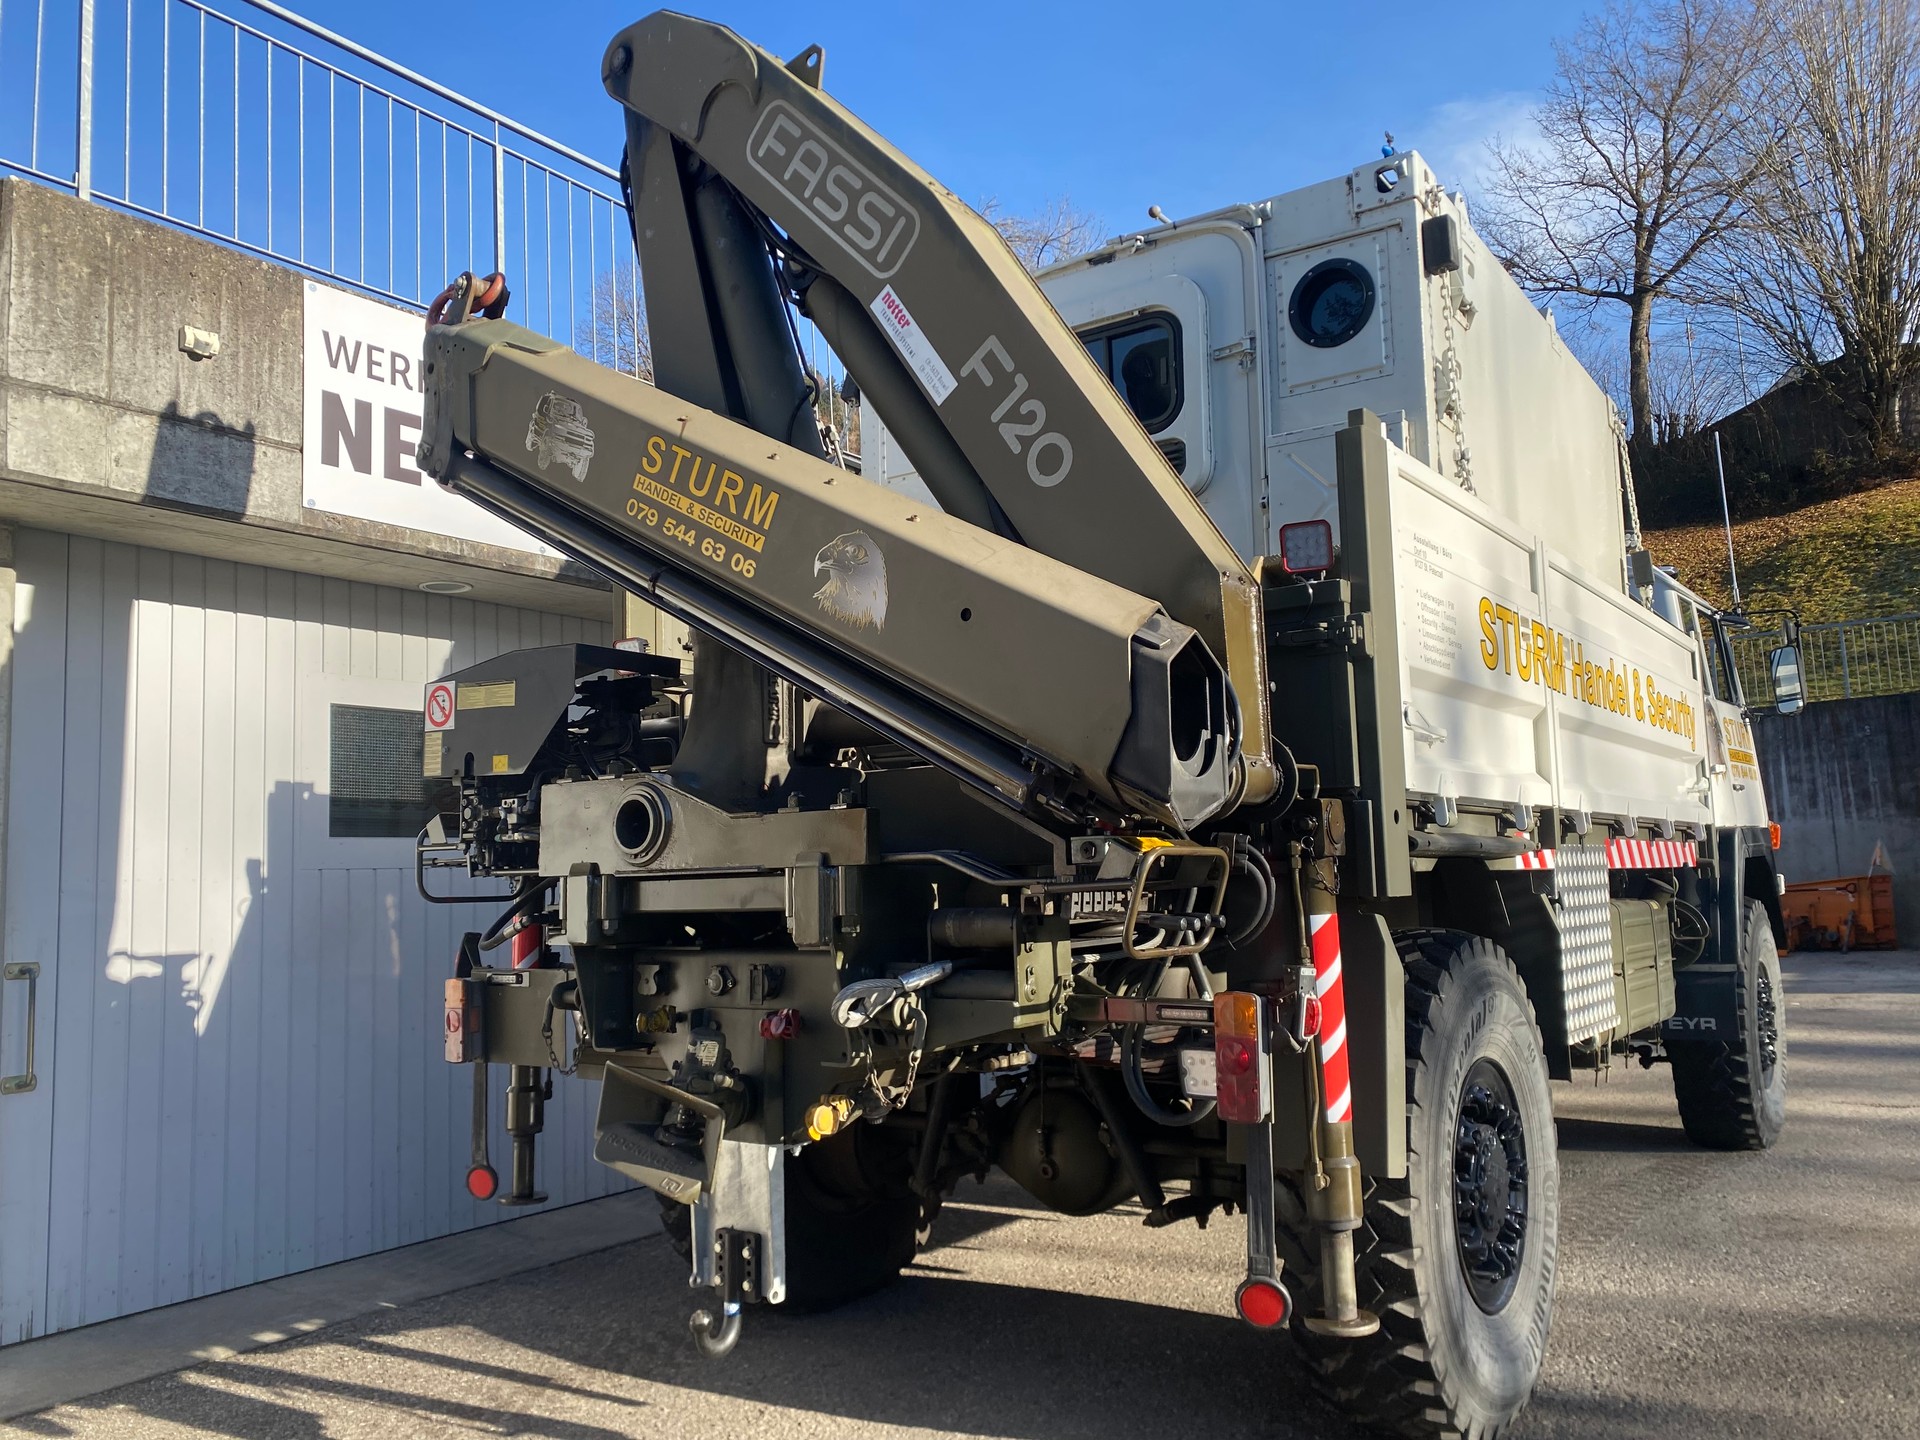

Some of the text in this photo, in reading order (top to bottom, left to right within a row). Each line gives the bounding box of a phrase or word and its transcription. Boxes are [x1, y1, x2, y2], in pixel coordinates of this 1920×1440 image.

[758, 112, 906, 263] FASSI
[881, 291, 911, 329] notter
[321, 329, 424, 393] WER
[321, 389, 426, 488] NE
[960, 335, 1073, 488] F120
[636, 476, 762, 549] HANDEL & SECURITY
[641, 435, 780, 530] STURM
[626, 498, 757, 578] 079 544 63 06
[1478, 596, 1697, 752] STURM Handel & Security
[1669, 1017, 1717, 1030] EYR
